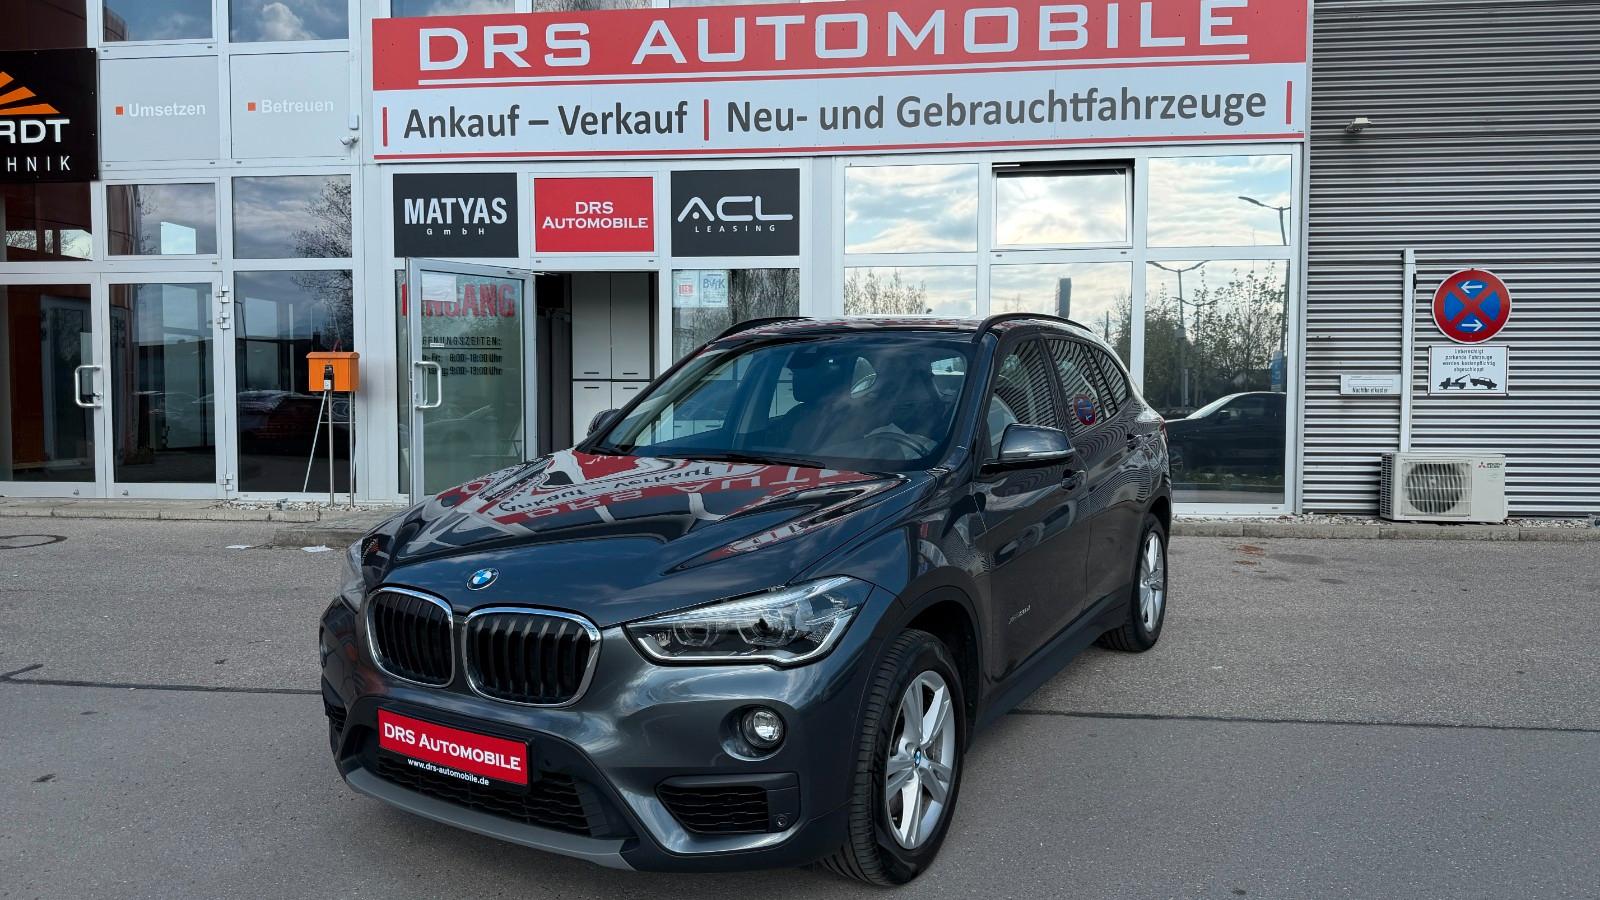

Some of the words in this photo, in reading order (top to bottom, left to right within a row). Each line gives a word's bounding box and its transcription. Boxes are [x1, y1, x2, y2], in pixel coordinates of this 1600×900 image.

[418, 22, 591, 71] DRS
[631, 0, 1249, 65] AUTOMOBILE
[128, 102, 206, 118] Umsetzen
[260, 99, 334, 114] Betreuen
[403, 104, 520, 139] Ankauf
[557, 101, 687, 136] Verkauf
[727, 101, 808, 133] Neu-
[819, 95, 884, 131] und
[896, 87, 1267, 128] Gebrauchtfahrzeuge
[404, 197, 508, 225] MATYAS
[575, 201, 614, 215] DRS
[677, 195, 794, 222] ACL
[542, 216, 649, 230] AUTOMOBILE
[695, 225, 776, 233] LEASING
[383, 722, 416, 746] DRS
[419, 733, 522, 772] AUTOMOBILE
[407, 758, 490, 786] www.drs-automobile.de
